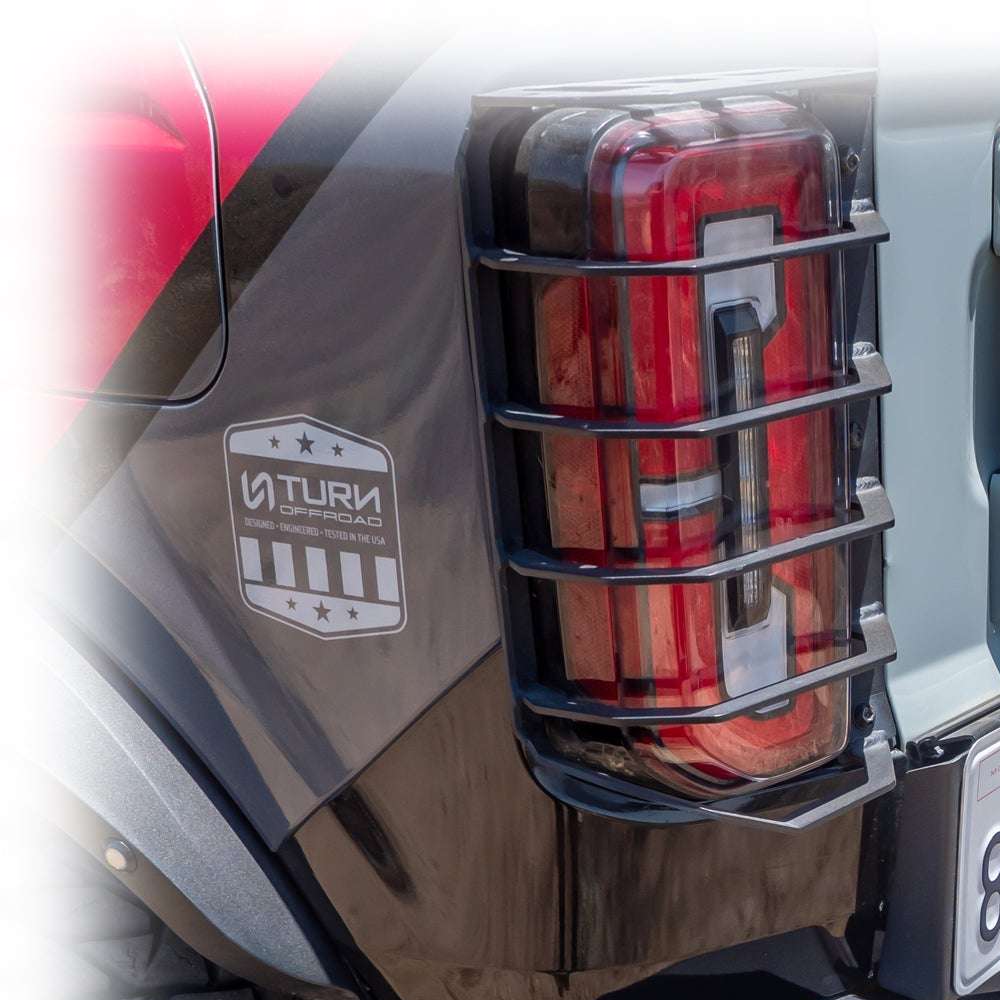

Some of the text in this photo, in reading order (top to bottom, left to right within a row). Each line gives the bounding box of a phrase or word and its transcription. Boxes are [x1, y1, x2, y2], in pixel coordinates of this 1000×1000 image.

[280, 504, 382, 527] OFFROAD
[245, 517, 386, 545] DESIGNED ENGINEERED TESTED IN THE USA
